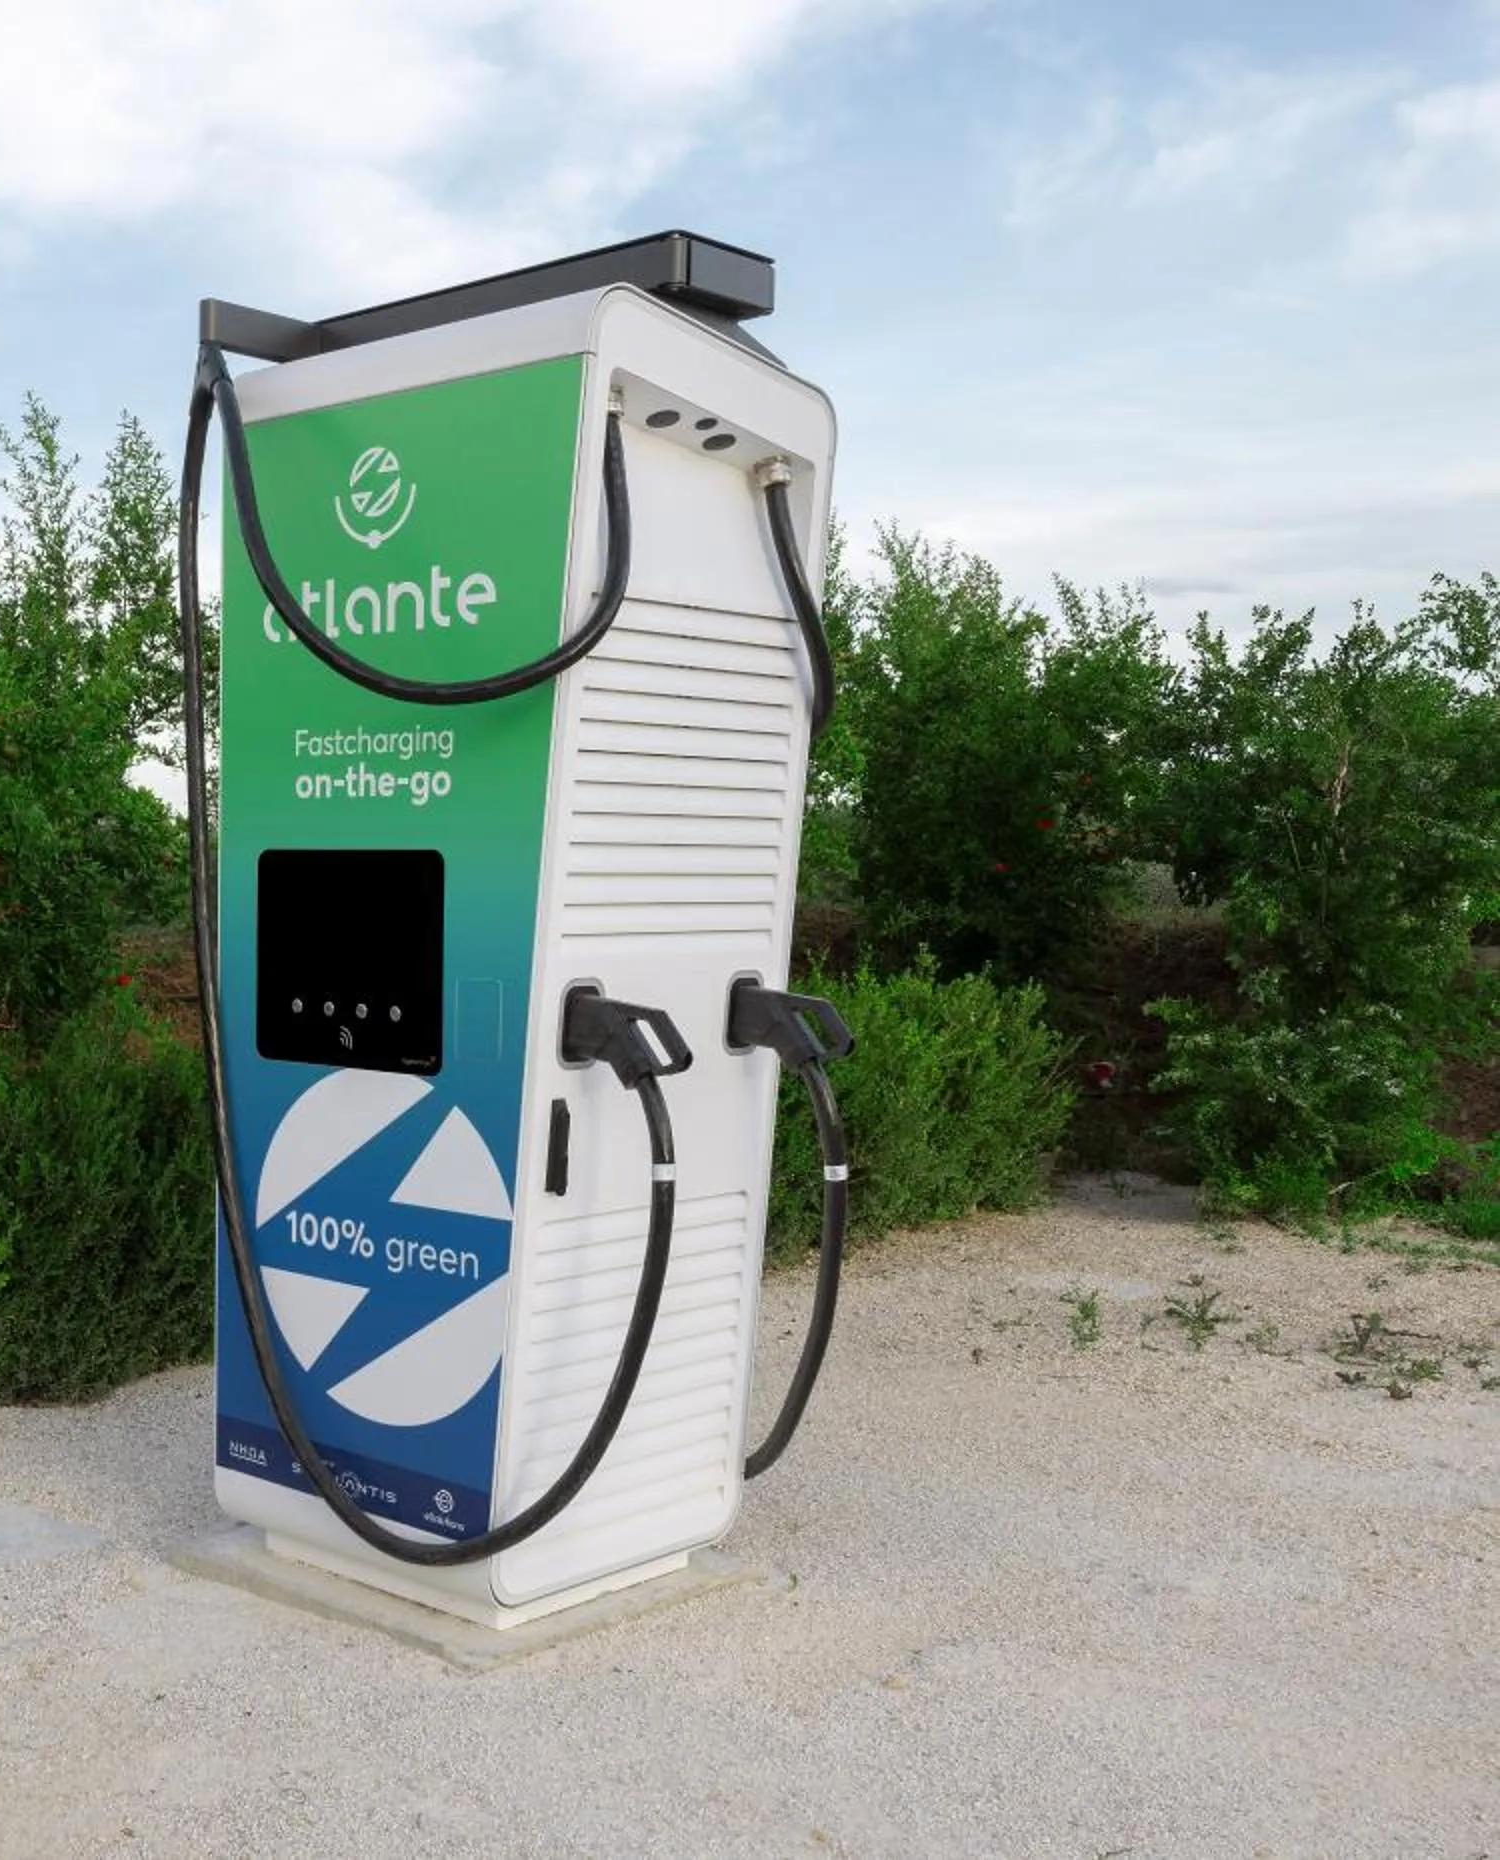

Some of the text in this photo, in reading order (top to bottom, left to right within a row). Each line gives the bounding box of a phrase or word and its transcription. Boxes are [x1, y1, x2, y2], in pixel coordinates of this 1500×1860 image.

[295, 724, 454, 761] Fastcharging
[295, 762, 452, 806] on-the-go
[285, 1210, 480, 1281] 100% green
